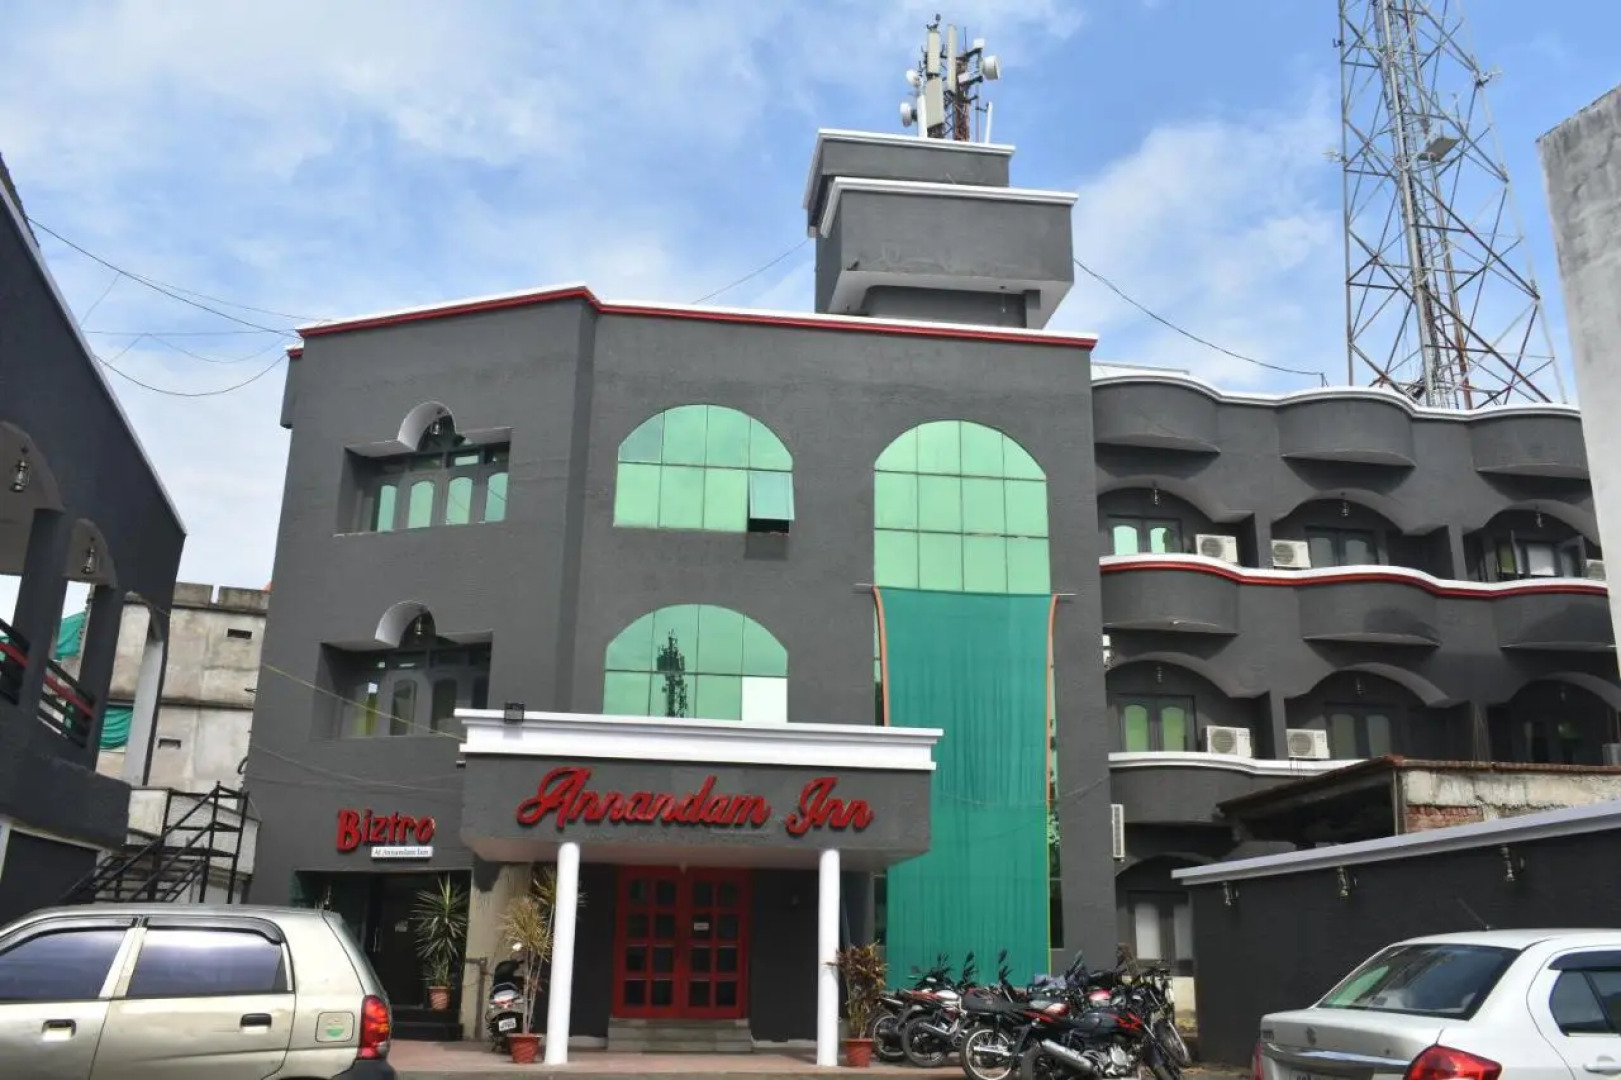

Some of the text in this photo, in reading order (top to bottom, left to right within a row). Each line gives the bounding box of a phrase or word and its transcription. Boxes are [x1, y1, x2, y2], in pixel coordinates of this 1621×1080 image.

[515, 766, 874, 836] Annandam Inn
[337, 808, 435, 852] Biztro
